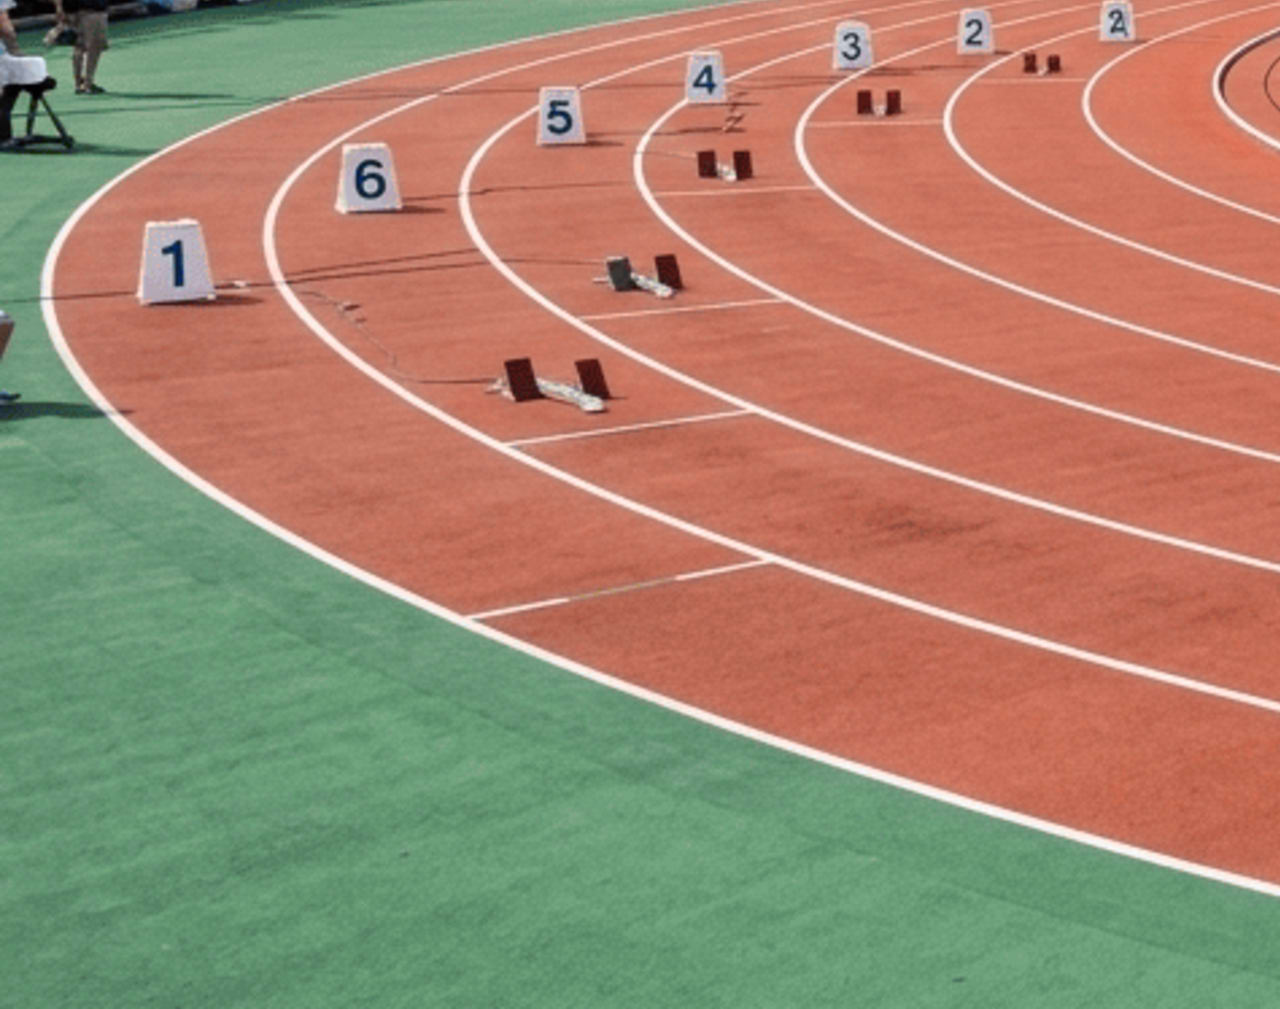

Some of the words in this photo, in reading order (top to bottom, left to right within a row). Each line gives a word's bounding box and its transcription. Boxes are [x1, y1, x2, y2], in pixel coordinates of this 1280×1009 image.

[841, 32, 862, 61] 3
[965, 19, 984, 47] 2
[692, 64, 717, 96] 4
[547, 99, 574, 135] 5
[355, 159, 387, 200] 6
[161, 239, 185, 288] 1
